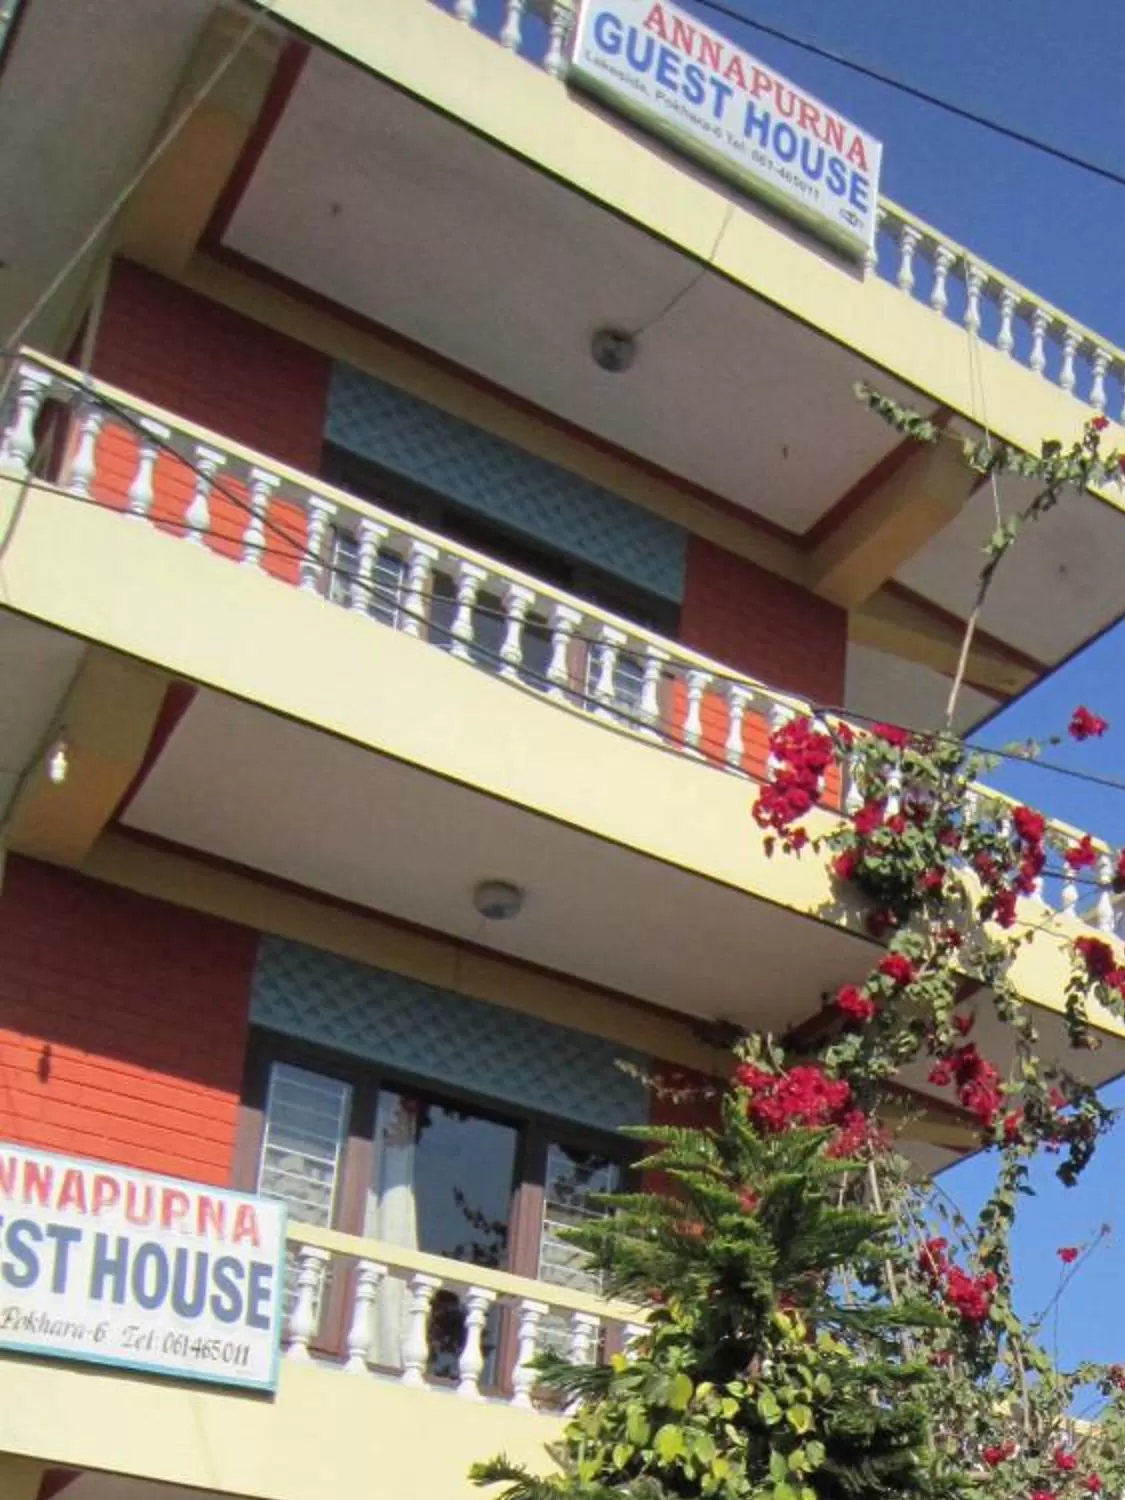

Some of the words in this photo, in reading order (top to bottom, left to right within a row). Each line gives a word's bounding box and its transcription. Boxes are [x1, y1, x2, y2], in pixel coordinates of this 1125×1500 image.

[593, 11, 733, 119] GUEST
[744, 100, 870, 214] HOUSE
[643, 3, 869, 172] ANNAPURNA
[0, 1215, 83, 1290] ST
[90, 1232, 274, 1330] HOUSE
